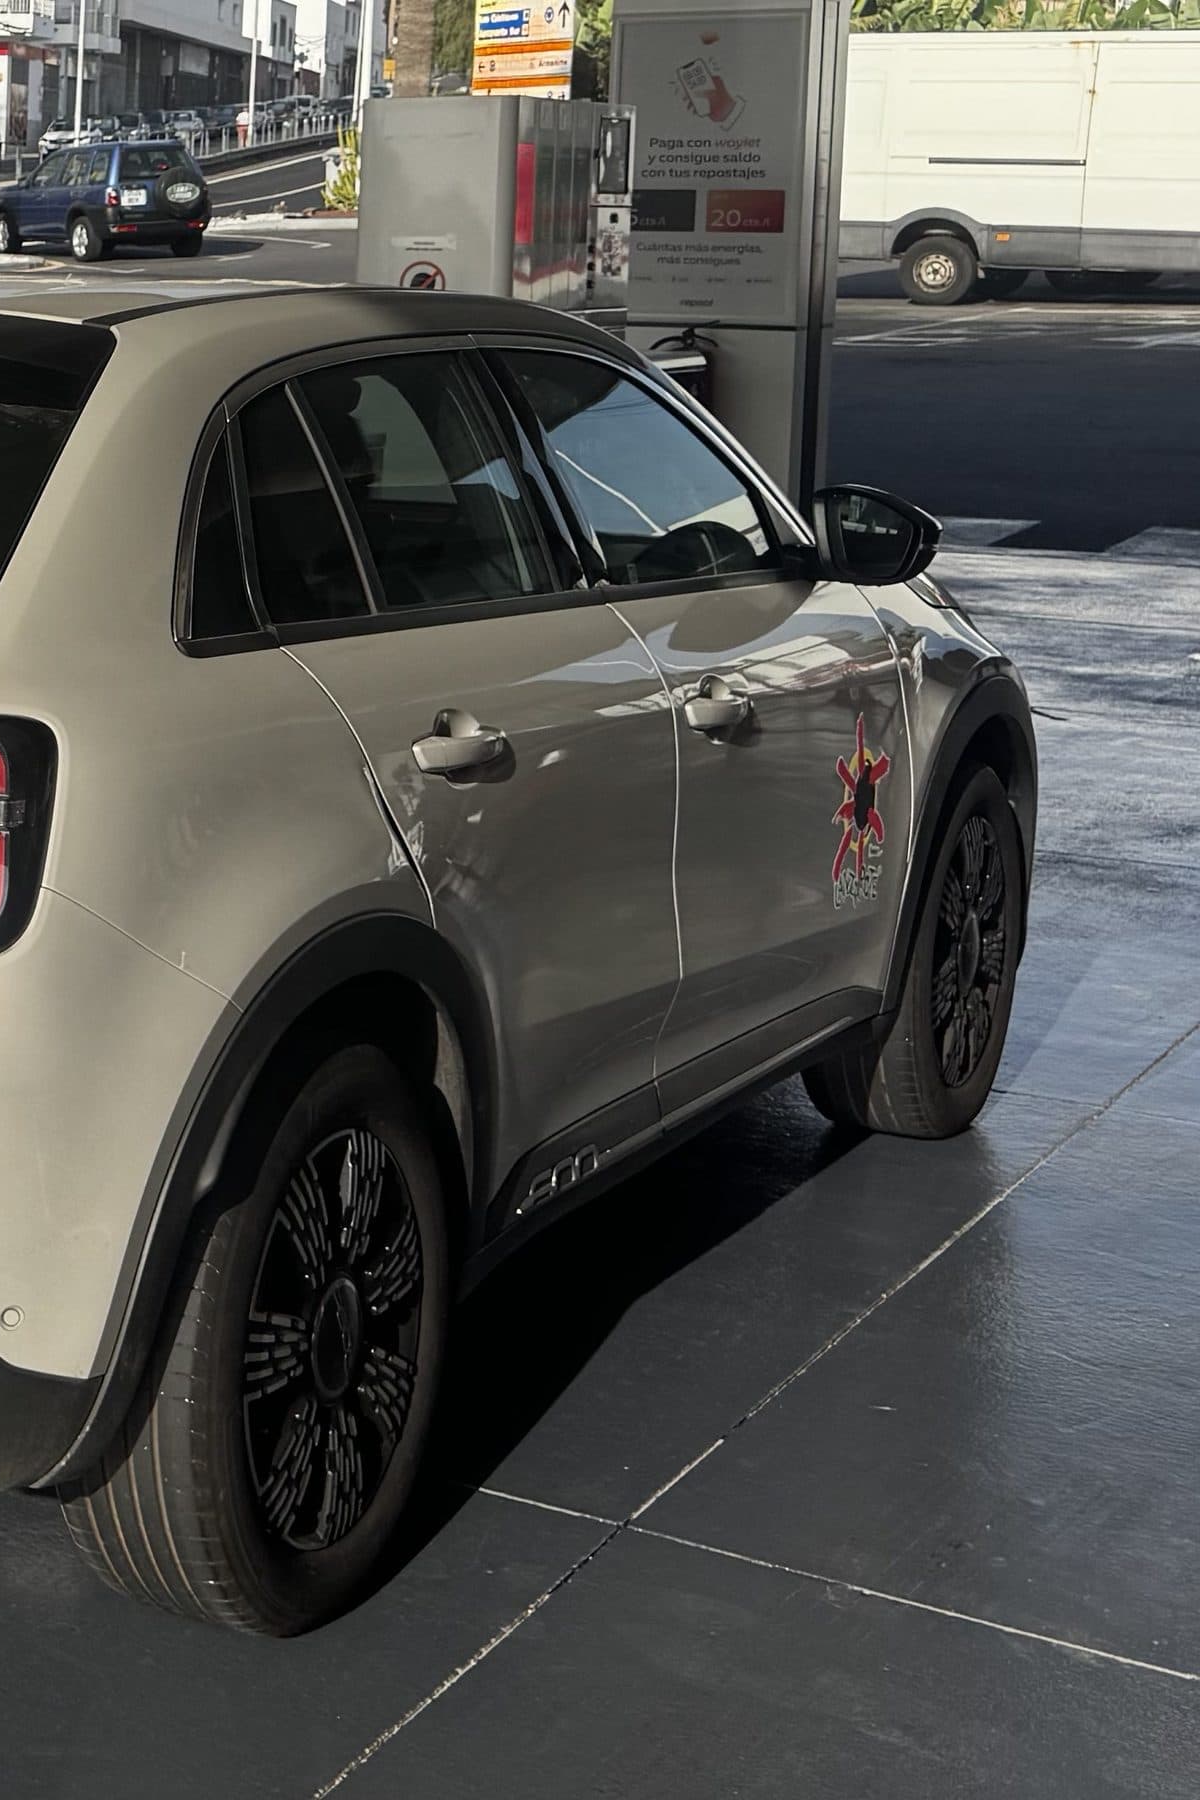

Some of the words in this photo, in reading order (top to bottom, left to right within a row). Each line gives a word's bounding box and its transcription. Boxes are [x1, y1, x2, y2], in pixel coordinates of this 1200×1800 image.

[649, 138, 683, 150] Paga
[686, 139, 711, 148] con
[648, 154, 656, 166] y
[658, 152, 720, 165] consigue
[723, 151, 761, 163] saldo
[641, 169, 665, 178] con
[669, 168, 689, 178] tus
[692, 168, 766, 180] repostajes
[711, 209, 741, 227] 20
[636, 242, 682, 252] Cuántas
[685, 242, 709, 252] más
[657, 255, 681, 265] más
[683, 256, 741, 267] consigues
